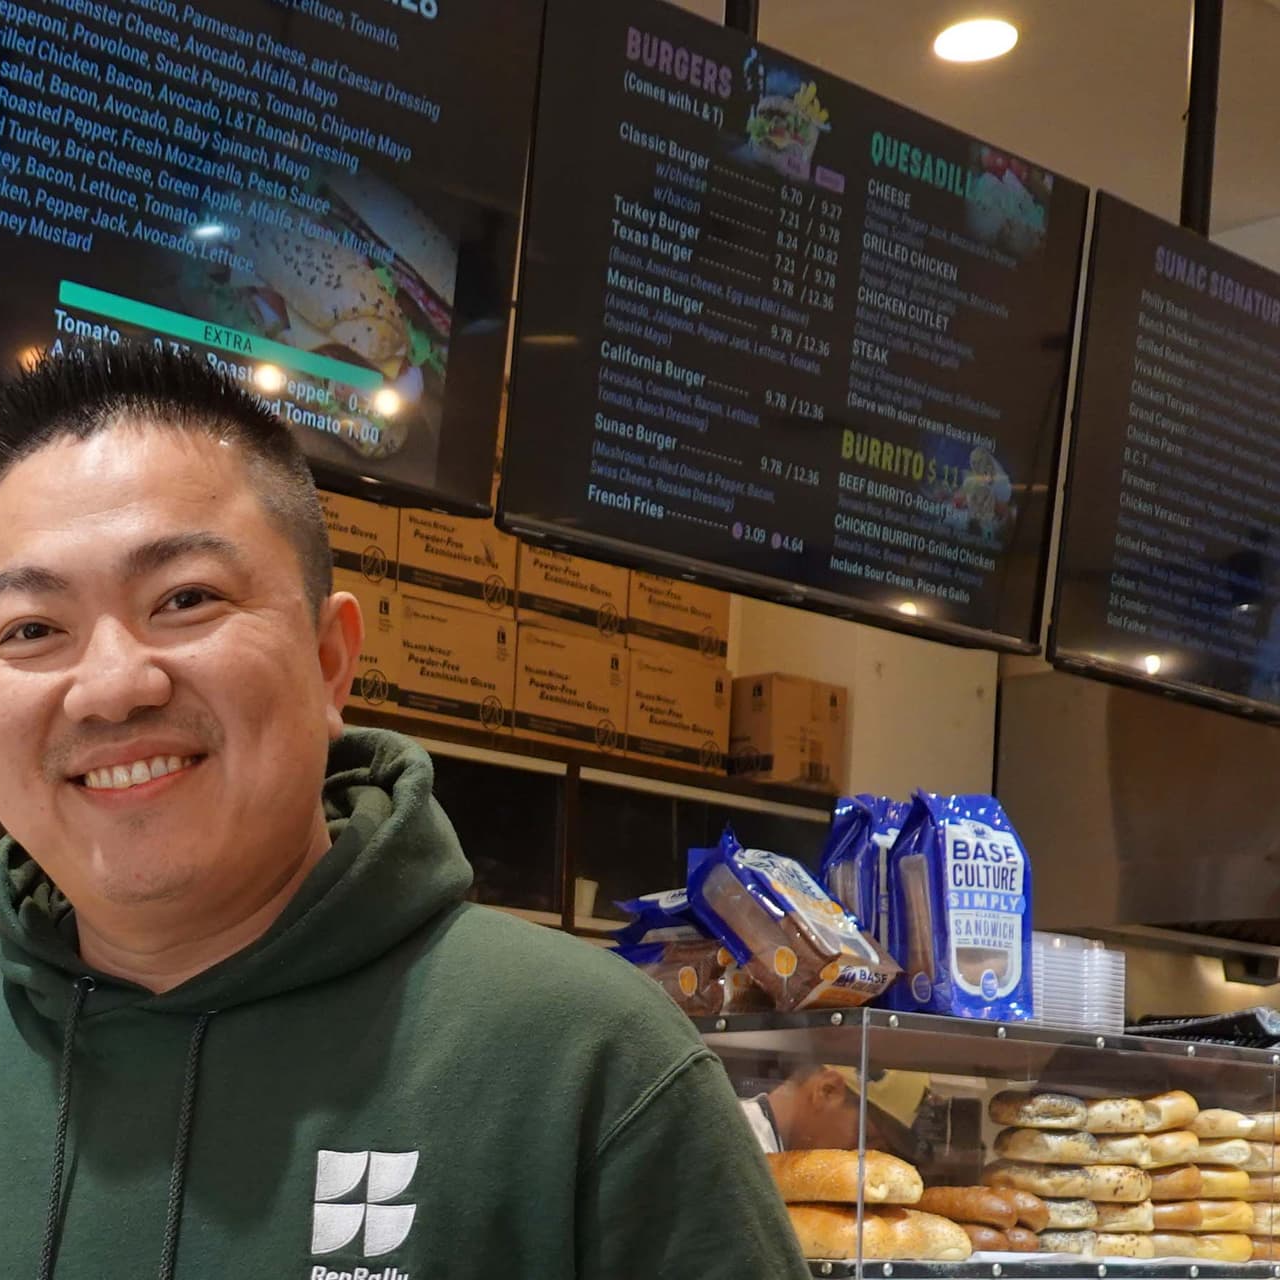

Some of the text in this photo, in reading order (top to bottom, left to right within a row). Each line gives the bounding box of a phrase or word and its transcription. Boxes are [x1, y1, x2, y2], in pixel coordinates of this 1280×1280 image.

[183, 4, 441, 123] Parmesan Cheese, Caesar Dressing
[625, 25, 733, 99] BURGERS
[73, 22, 412, 163] Provolone, Snack Peppers, Chipotle Mayo
[623, 71, 667, 102] (Comes
[0, 60, 46, 96] salad,
[173, 116, 211, 150] Baby
[212, 131, 270, 170] Spinach,
[38, 40, 102, 83] Chicken,
[256, 121, 299, 149] Ranch
[300, 133, 360, 175] Dressing
[64, 109, 119, 147] Pepper,
[164, 143, 245, 190] Mozzarella,
[64, 138, 96, 166] Brie
[619, 121, 711, 171] Classic Burger
[25, 155, 77, 192] Bacon,
[35, 187, 90, 220] Pepper
[867, 178, 912, 210] CHEESE
[28, 215, 94, 253] Mustard
[613, 194, 701, 241] Turkey Burger
[611, 218, 694, 263] Texas Burger
[863, 232, 908, 264] GRILLED
[910, 250, 958, 281] CHICKEN
[606, 267, 704, 315] Mexican Burger
[857, 285, 907, 318] CHICKEN
[908, 302, 950, 332] CUTLET
[1209, 271, 1280, 327] SIGNATUR
[54, 308, 121, 347] Tomato
[203, 324, 253, 354] EXTRA
[600, 339, 707, 389] California Burger
[852, 338, 888, 365] STEAK
[284, 402, 342, 436] Tomato
[594, 411, 678, 452] Sunac Burger
[840, 428, 924, 481] BURRITO
[587, 483, 665, 520] French Fries
[833, 513, 881, 540] CHICKEN
[829, 555, 863, 577] Include
[952, 839, 1019, 866] BASE
[952, 863, 1018, 892] CULTURE
[949, 891, 1020, 912] SIMPLY
[955, 919, 1015, 941] SANDWICH
[859, 969, 888, 984] BASE
